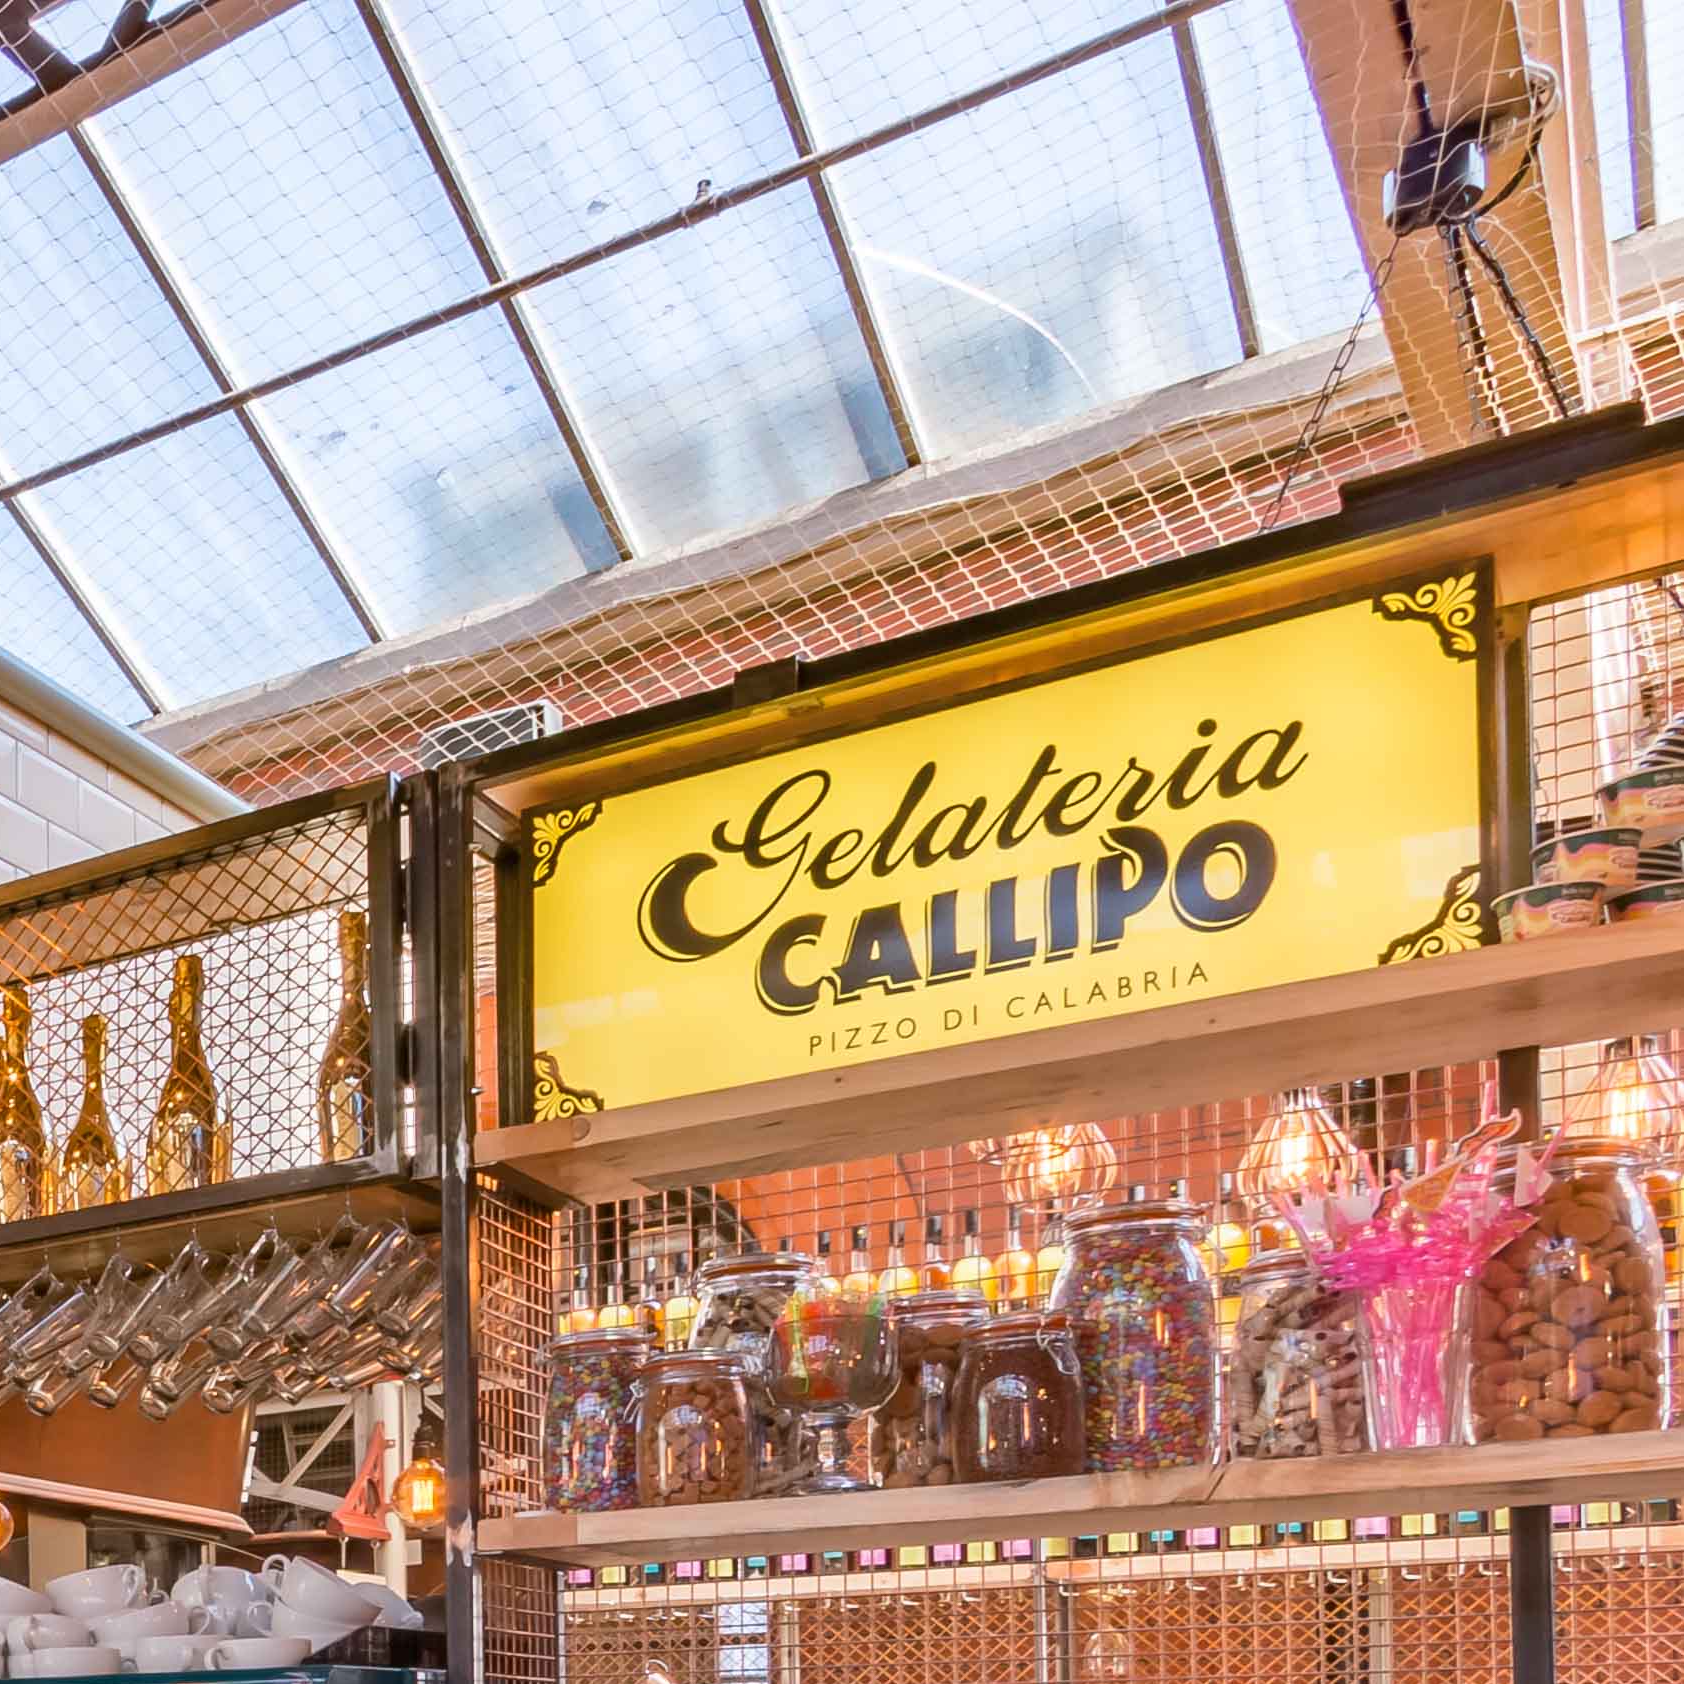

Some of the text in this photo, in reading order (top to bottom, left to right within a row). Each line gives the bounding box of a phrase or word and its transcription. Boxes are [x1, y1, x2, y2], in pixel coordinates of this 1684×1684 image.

[639, 718, 1309, 962] Gelateria
[754, 819, 1277, 1016] CALLIPO
[808, 961, 1210, 1056] PIZZO DI CALABRIA
